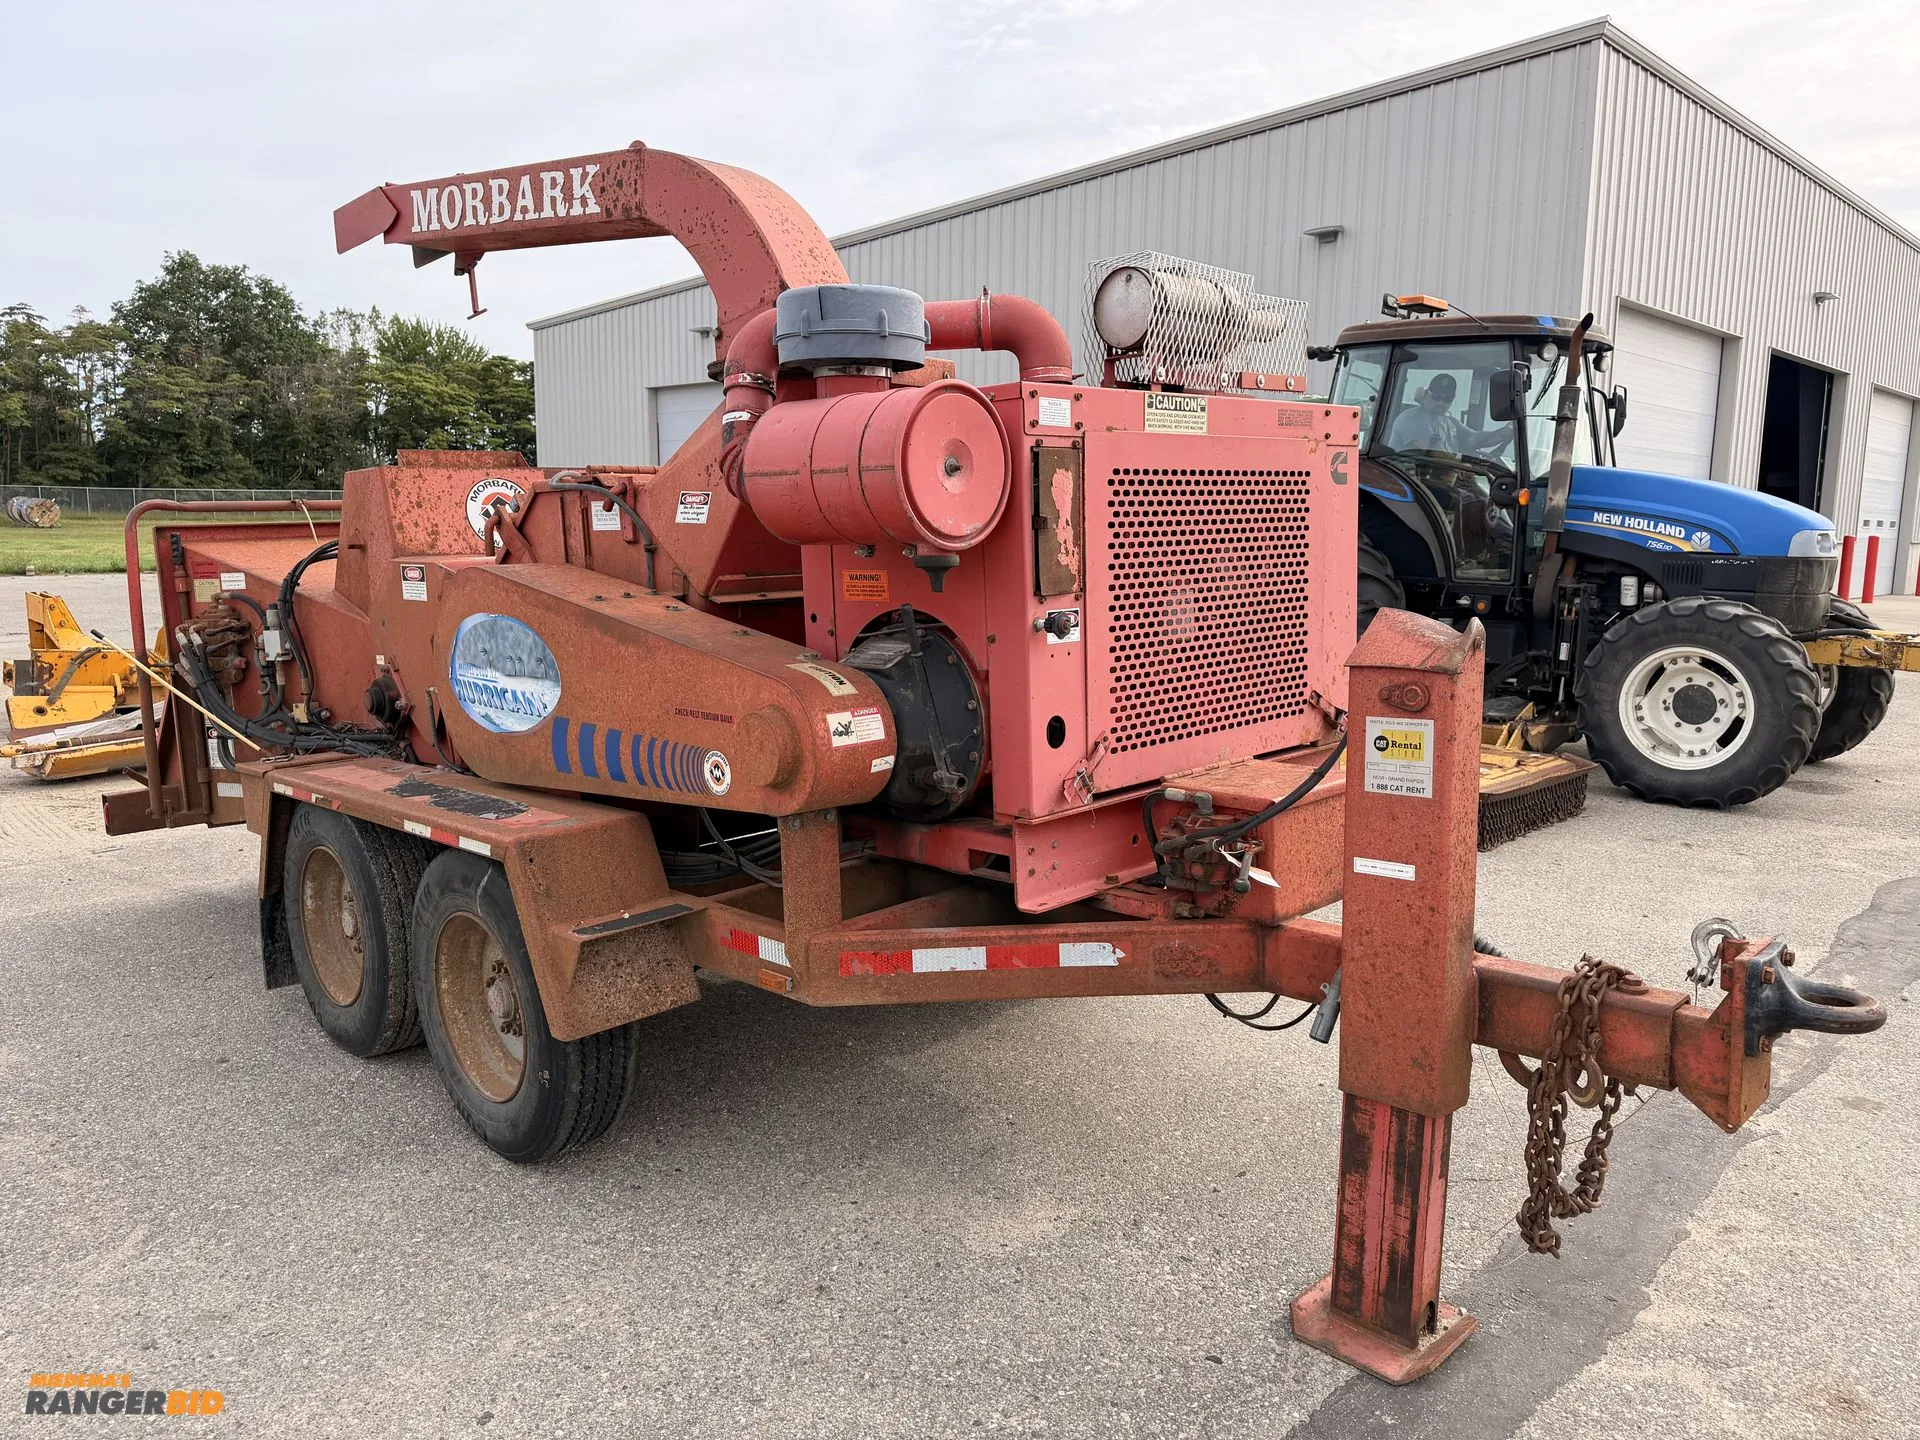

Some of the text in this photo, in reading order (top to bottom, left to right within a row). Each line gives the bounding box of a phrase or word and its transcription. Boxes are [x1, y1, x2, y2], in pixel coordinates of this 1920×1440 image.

[410, 163, 601, 233] MORBARK
[1156, 396, 1197, 411] CAUTION
[470, 480, 521, 502] MORBAR
[1592, 512, 1686, 539] NEW HOLLAND
[849, 573, 881, 581] WARNING!
[808, 666, 847, 686] CAUTION
[675, 708, 689, 717] CHECK
[690, 710, 700, 718] BELT
[858, 707, 878, 715] DANGER
[1375, 740, 1422, 750] CAT Rental
